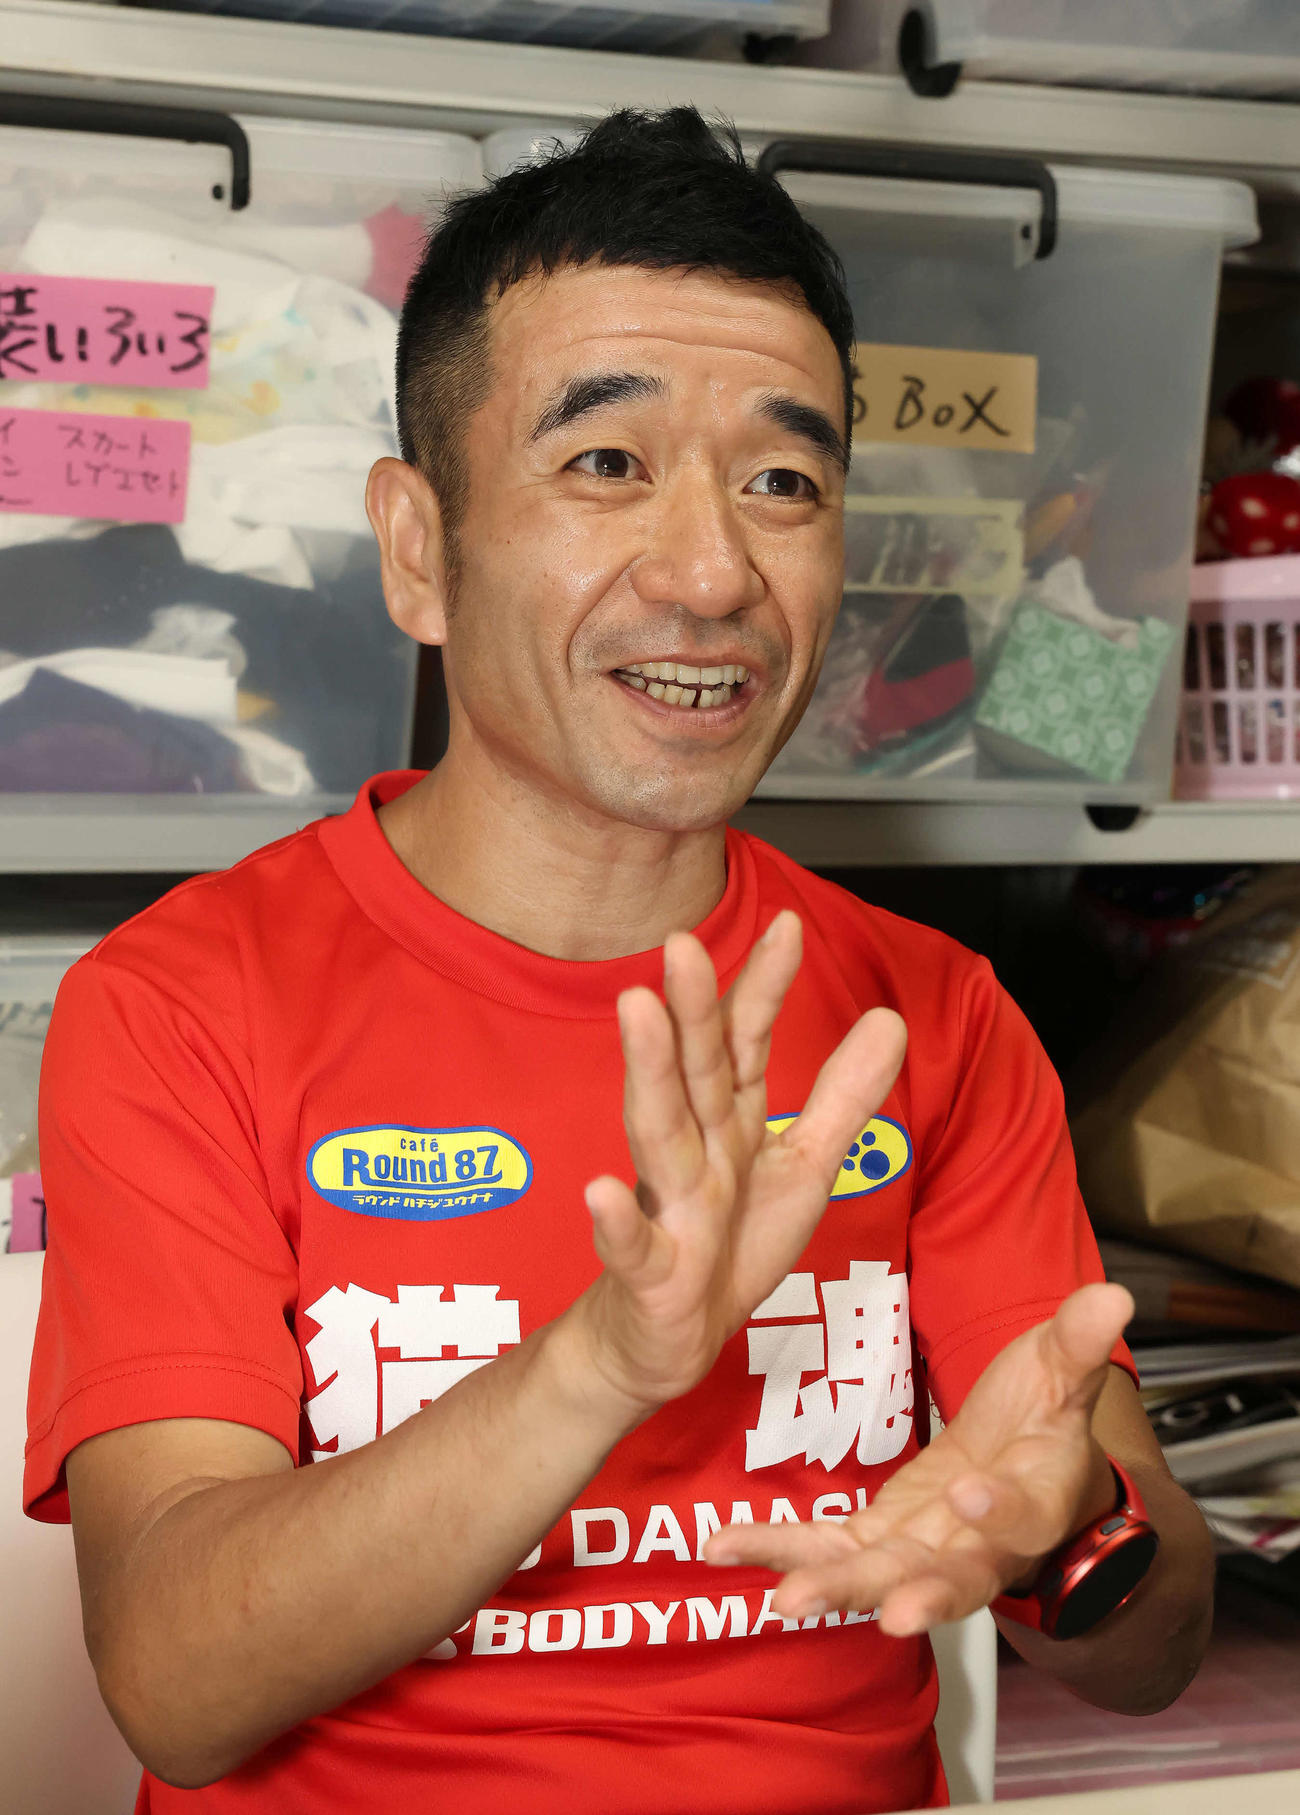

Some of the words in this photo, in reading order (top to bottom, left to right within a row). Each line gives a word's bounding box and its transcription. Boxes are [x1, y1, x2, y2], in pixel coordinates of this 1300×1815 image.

[57, 424, 157, 460] スカート
[400, 1137, 439, 1152] café
[342, 1147, 448, 1187] Round
[454, 1145, 500, 1181] 87
[353, 1194, 400, 1206] ラウンド
[745, 1260, 914, 1472] 魂
[471, 1589, 881, 1656] BODYMA
